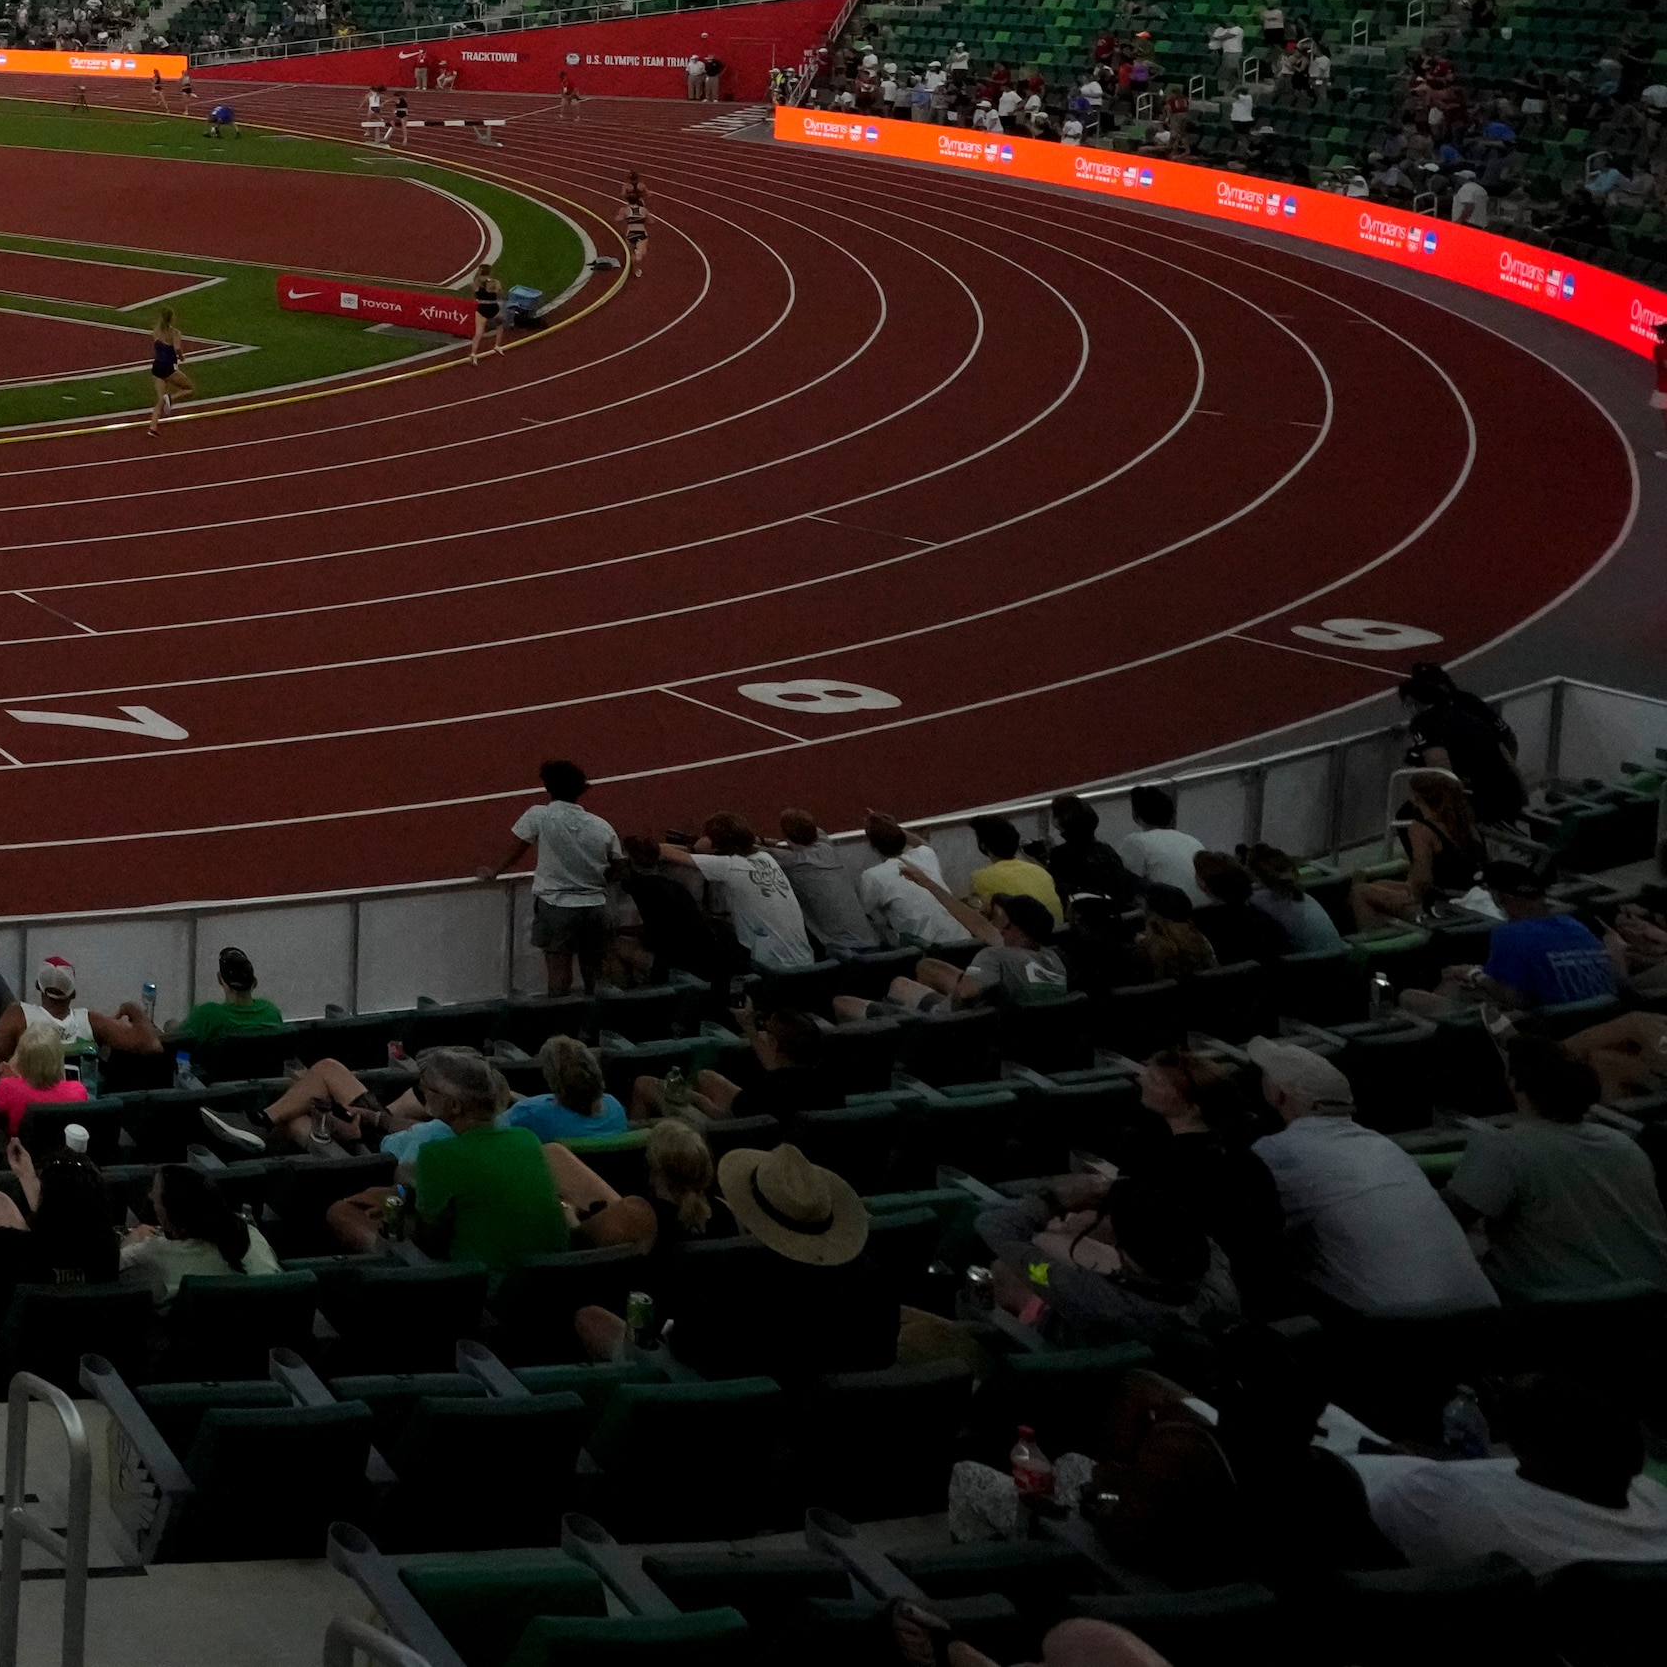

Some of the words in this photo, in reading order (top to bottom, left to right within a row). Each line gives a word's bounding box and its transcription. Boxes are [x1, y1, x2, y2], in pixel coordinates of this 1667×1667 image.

[69, 56, 107, 67] Olympians
[461, 51, 517, 63] TRACKTOWN
[586, 54, 602, 65] U.S.
[604, 55, 639, 66] OLYMPIC
[642, 56, 664, 67] TEAM
[803, 117, 847, 134] Olympians
[938, 135, 982, 153] Olympians
[1075, 156, 1121, 178] Olympians
[1217, 182, 1264, 205] Olympians
[1359, 212, 1406, 240] Olympians
[1499, 251, 1545, 282] Olympians
[361, 298, 403, 312] TOYOTA
[418, 305, 469, 325] xfinity
[1290, 618, 1445, 651] 9
[737, 678, 903, 715] 8
[5, 705, 189, 741] 7
